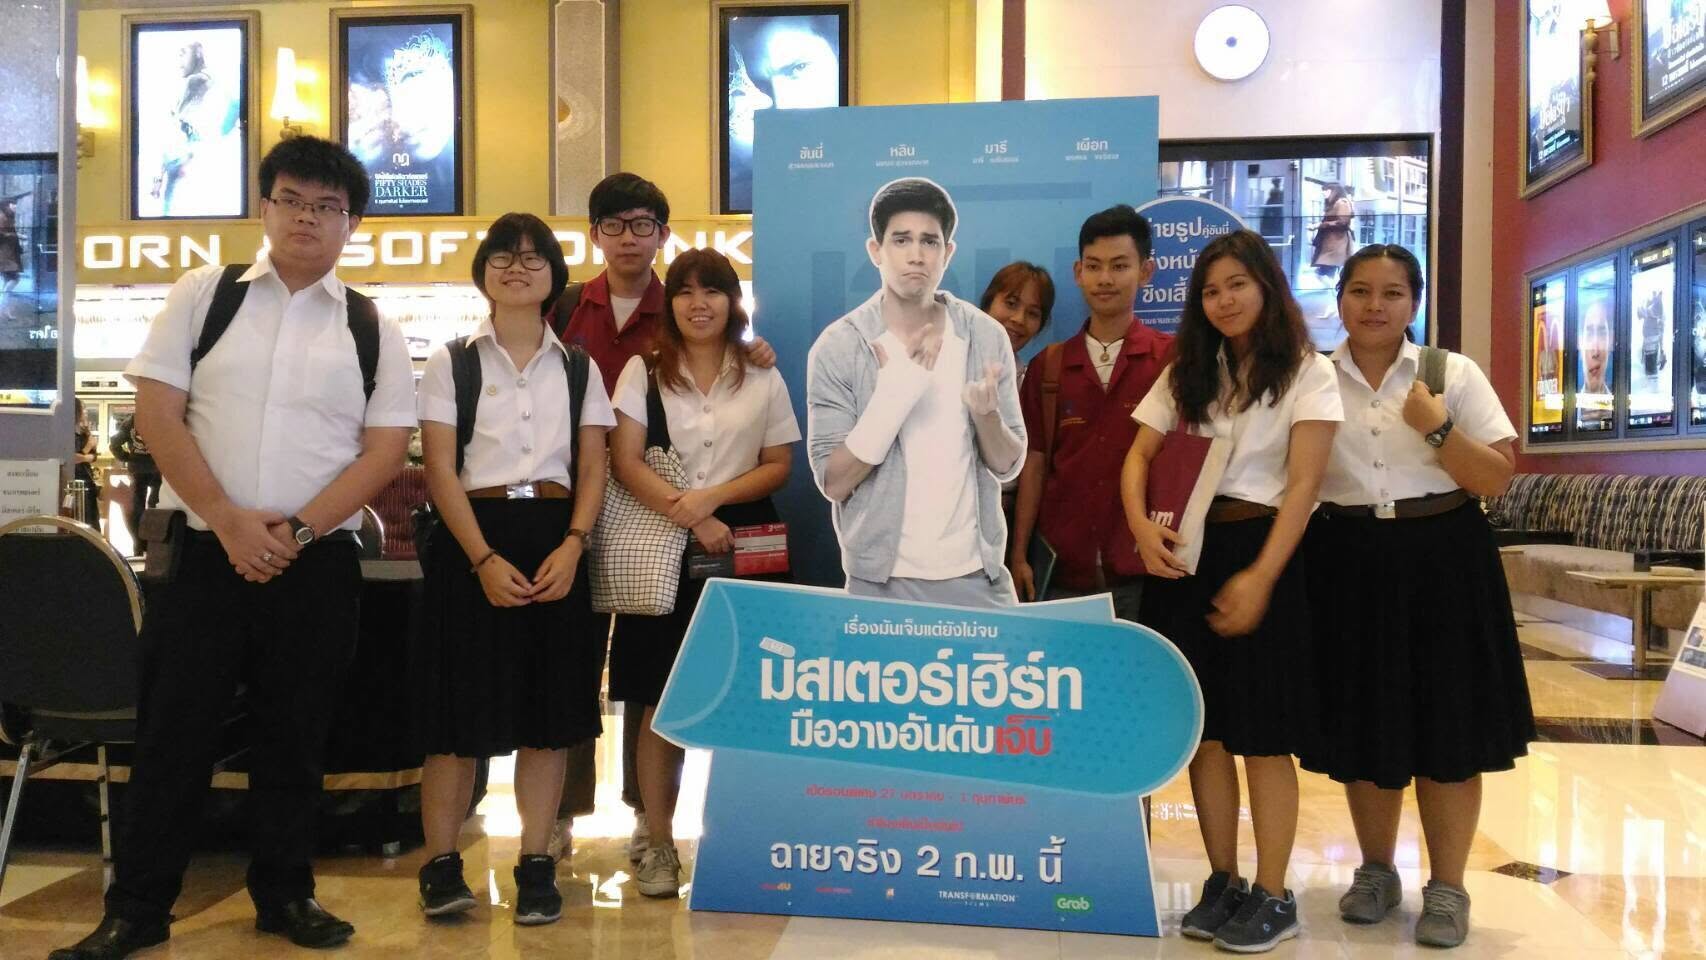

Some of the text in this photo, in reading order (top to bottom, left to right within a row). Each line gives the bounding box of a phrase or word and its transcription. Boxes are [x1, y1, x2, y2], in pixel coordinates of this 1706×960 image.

[890, 144, 915, 157] หลิน
[985, 140, 1008, 154] มารี
[375, 179, 396, 187] FIFTY
[375, 186, 428, 197] DARKER
[337, 231, 489, 266] SOF
[844, 614, 998, 638] เรื่องมันเจ็บแต่ยังไม่จบ
[759, 636, 1083, 710] มิสเตอร์เฮิร์ท
[770, 835, 1066, 883] ฉายจริง 2 ก.พ. นี้
[1056, 897, 1091, 911] Grab
